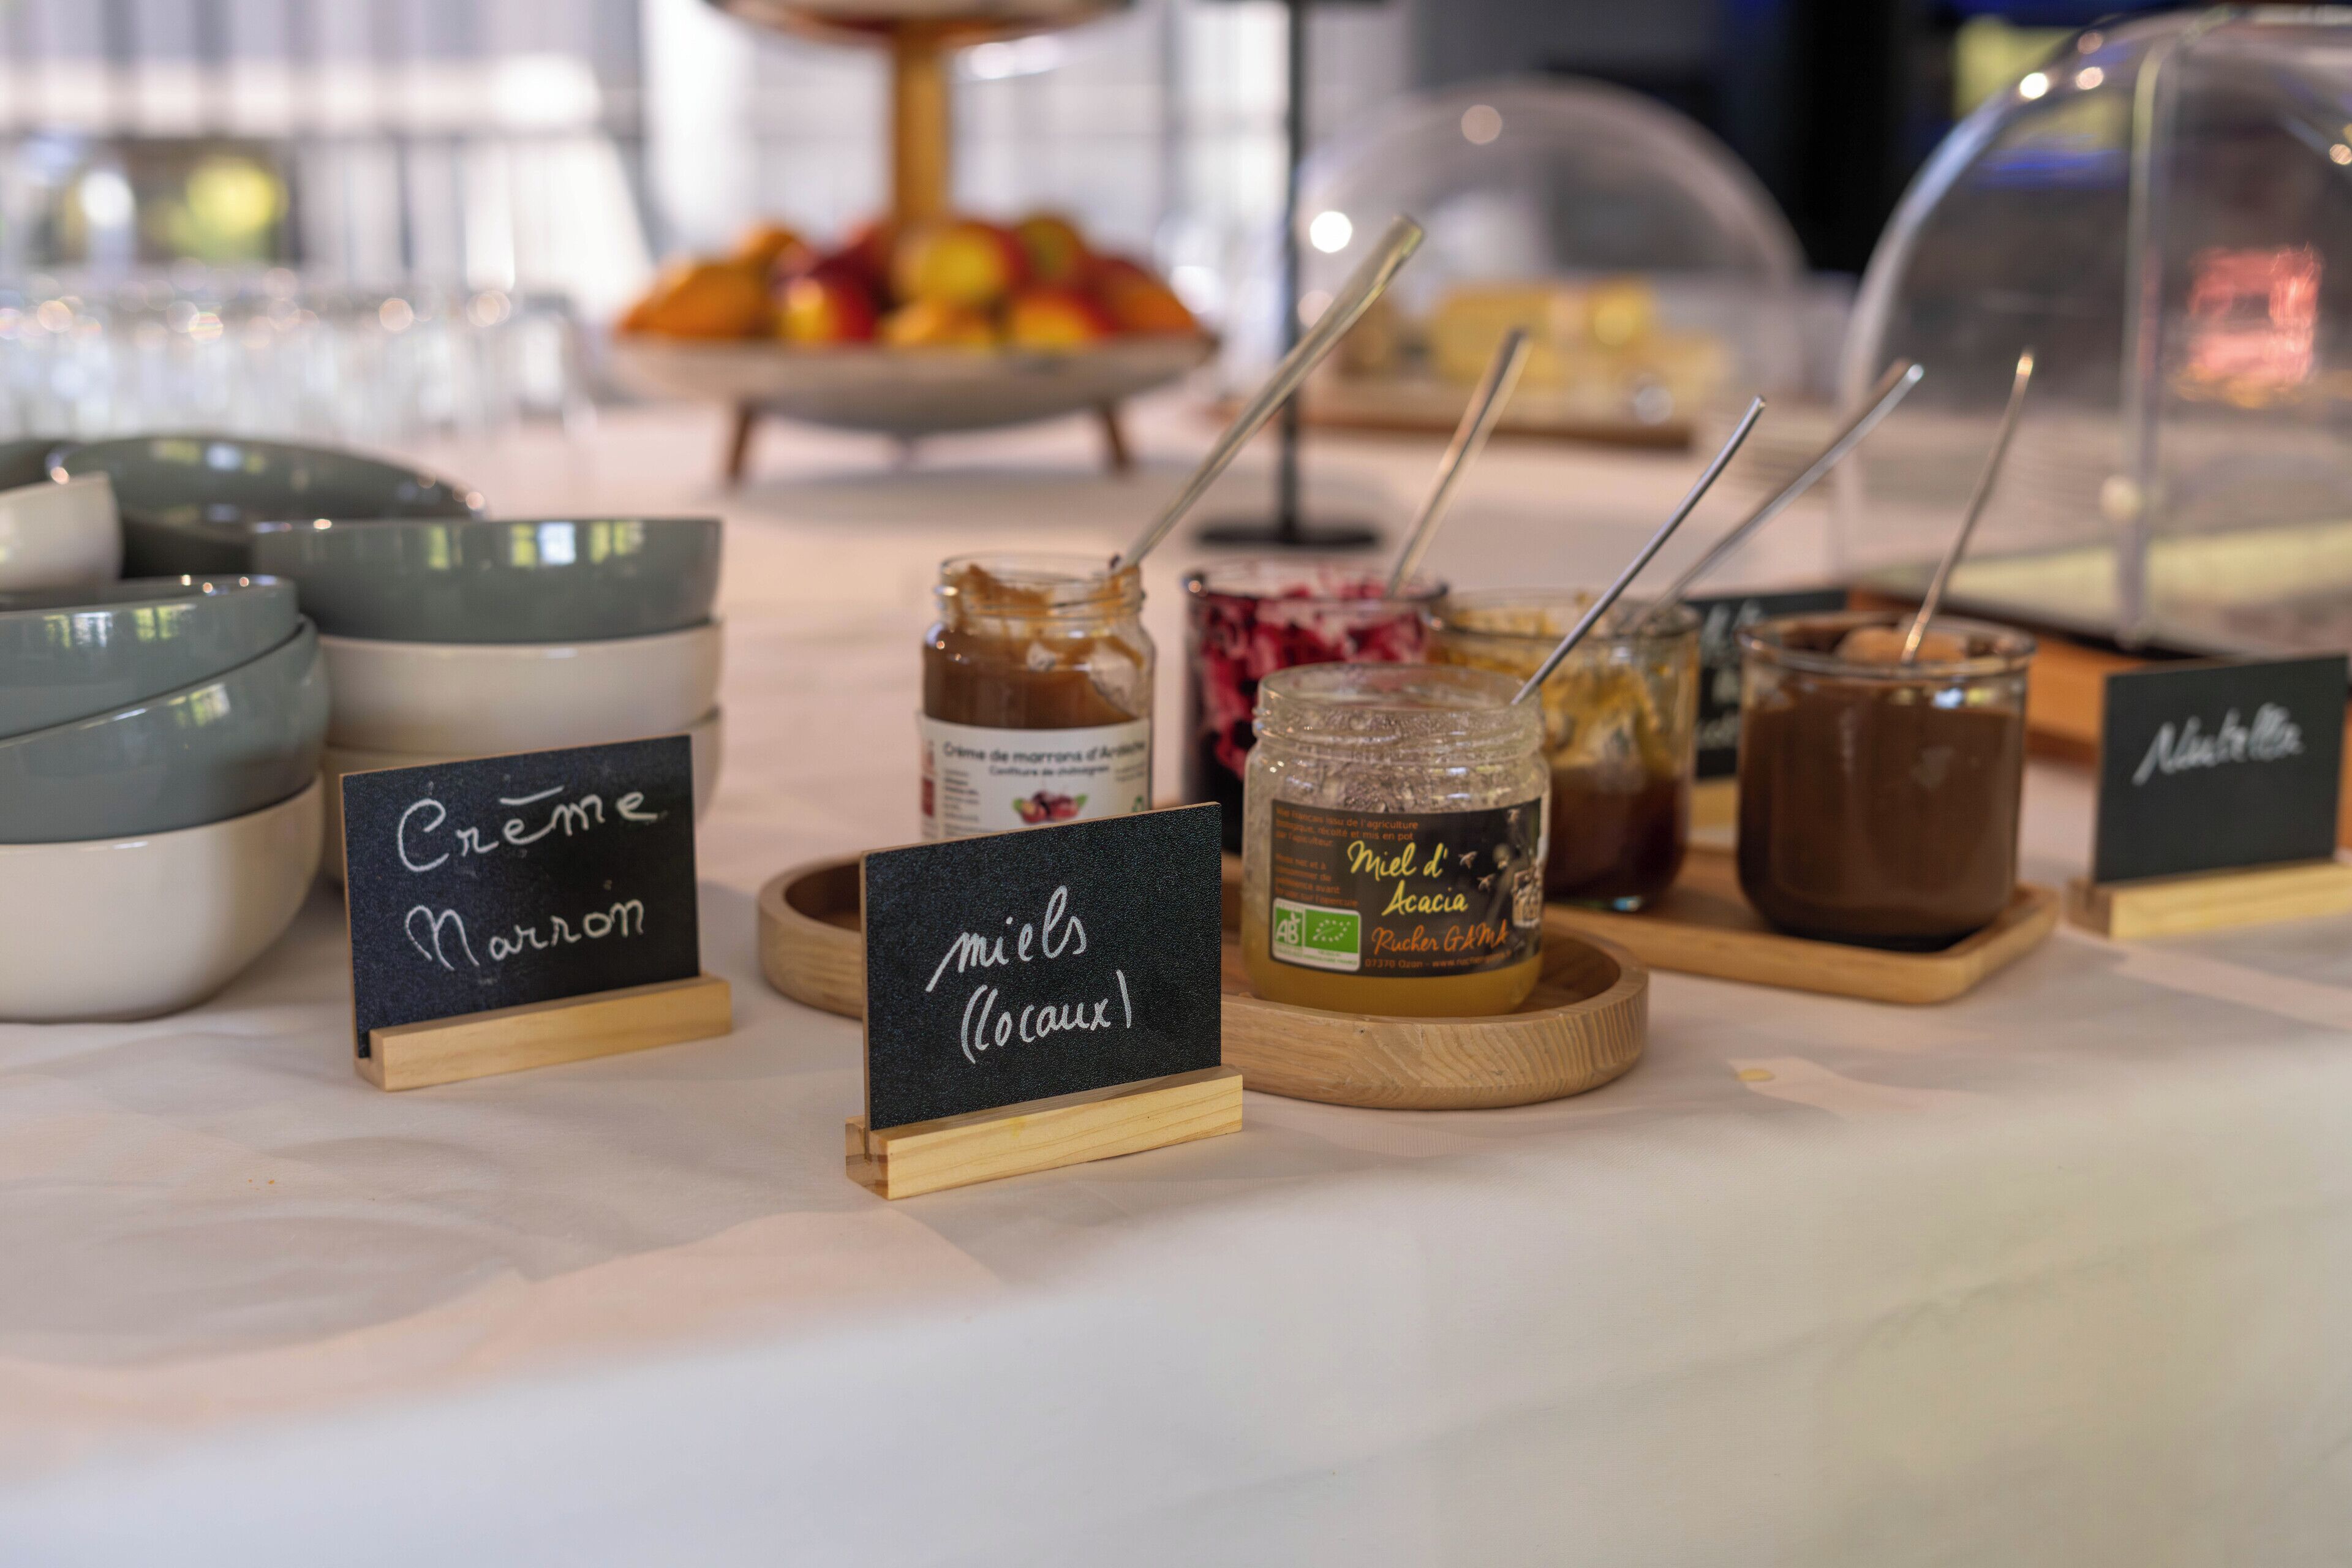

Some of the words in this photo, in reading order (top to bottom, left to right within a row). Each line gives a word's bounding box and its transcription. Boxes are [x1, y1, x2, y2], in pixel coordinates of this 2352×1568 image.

[943, 741, 986, 761] Crème
[990, 748, 1009, 761] de
[1012, 750, 1082, 763] marrons
[1347, 818, 1358, 827] de
[1397, 832, 1414, 842] pot
[1347, 840, 1417, 881] Miel
[1422, 842, 1449, 878] d'
[1381, 880, 1469, 916] Acacia
[404, 899, 644, 971] Marron
[925, 885, 1087, 992] miels
[1276, 912, 1300, 944] AB
[1371, 924, 1439, 956] Rucher
[1443, 918, 1510, 952] GAMA
[960, 969, 1131, 1064] (locaux)
